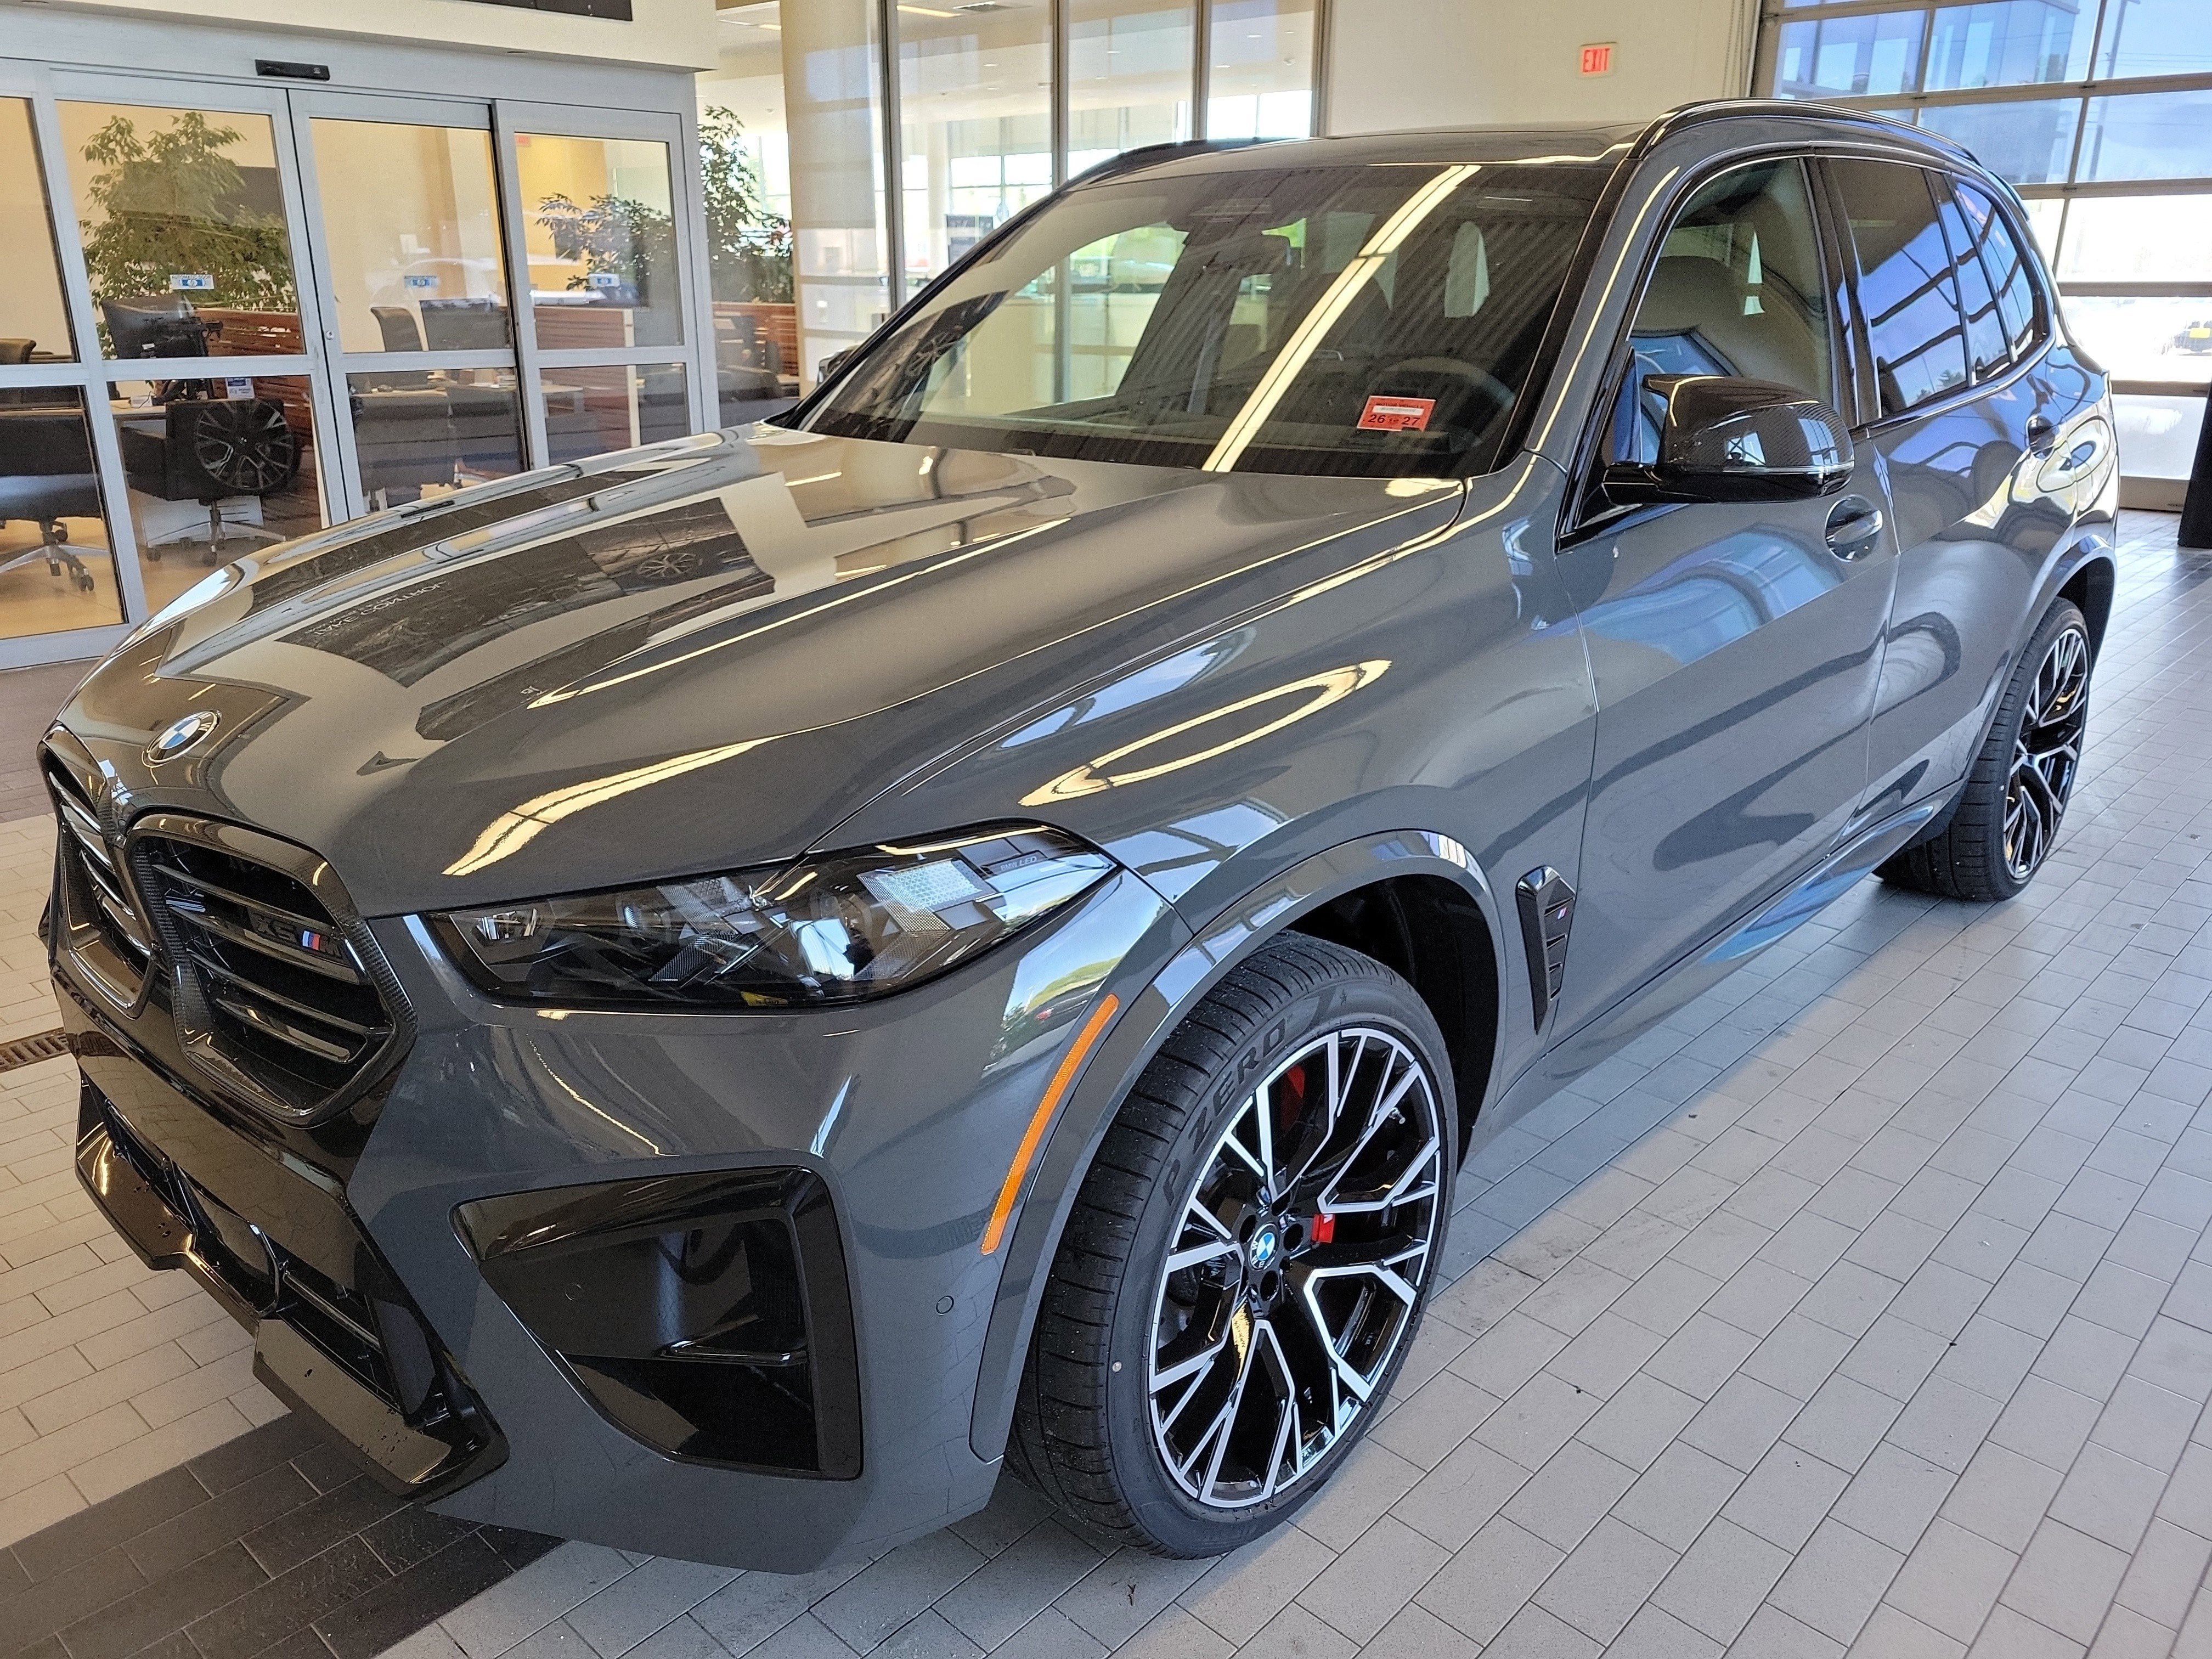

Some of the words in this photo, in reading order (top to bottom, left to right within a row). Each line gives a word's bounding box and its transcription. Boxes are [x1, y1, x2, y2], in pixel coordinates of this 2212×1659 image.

[1368, 414, 1386, 424] 26
[1401, 416, 1420, 426] 27
[1019, 856, 1037, 866] LED
[1188, 1018, 1285, 1155] ZERO
